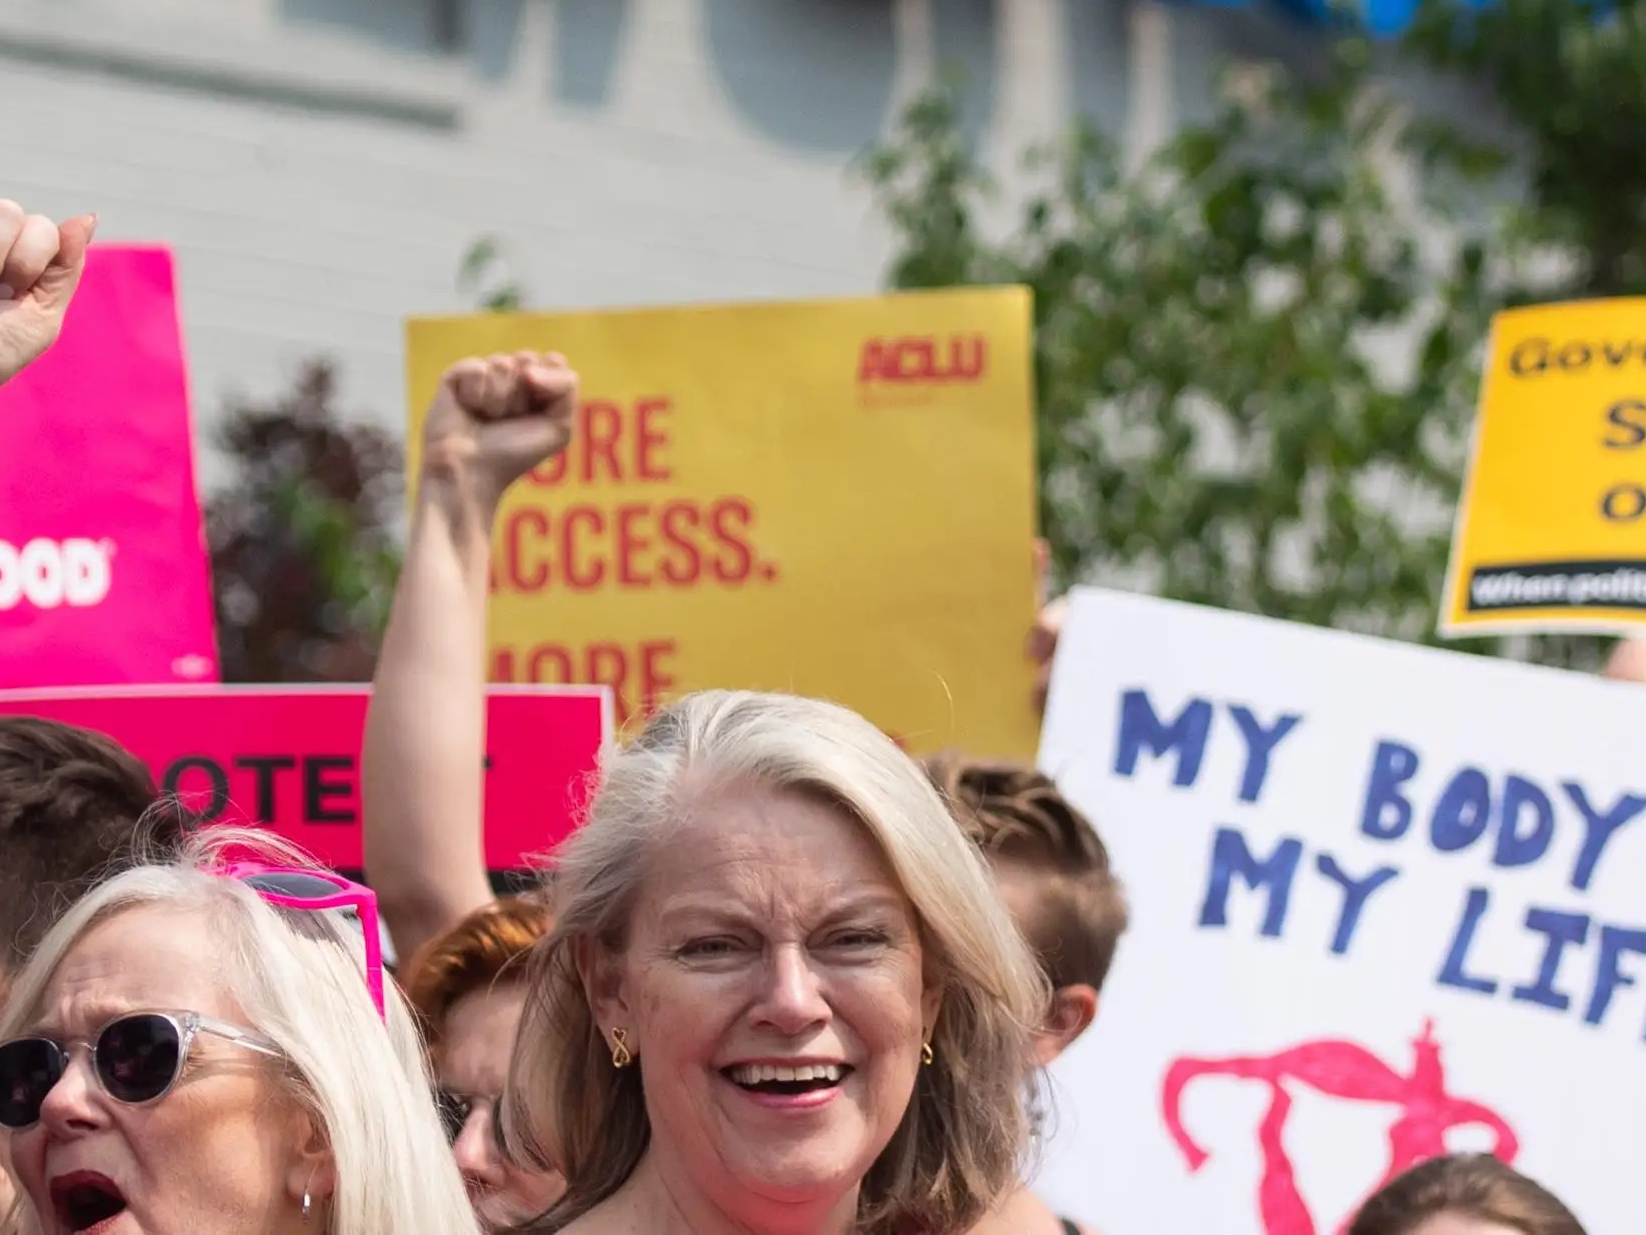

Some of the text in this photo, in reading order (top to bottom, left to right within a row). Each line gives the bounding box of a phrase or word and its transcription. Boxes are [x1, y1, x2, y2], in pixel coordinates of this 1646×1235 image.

[488, 496, 780, 593] CCESS.
[1112, 688, 1303, 803] MY
[1195, 826, 1400, 955] MY
